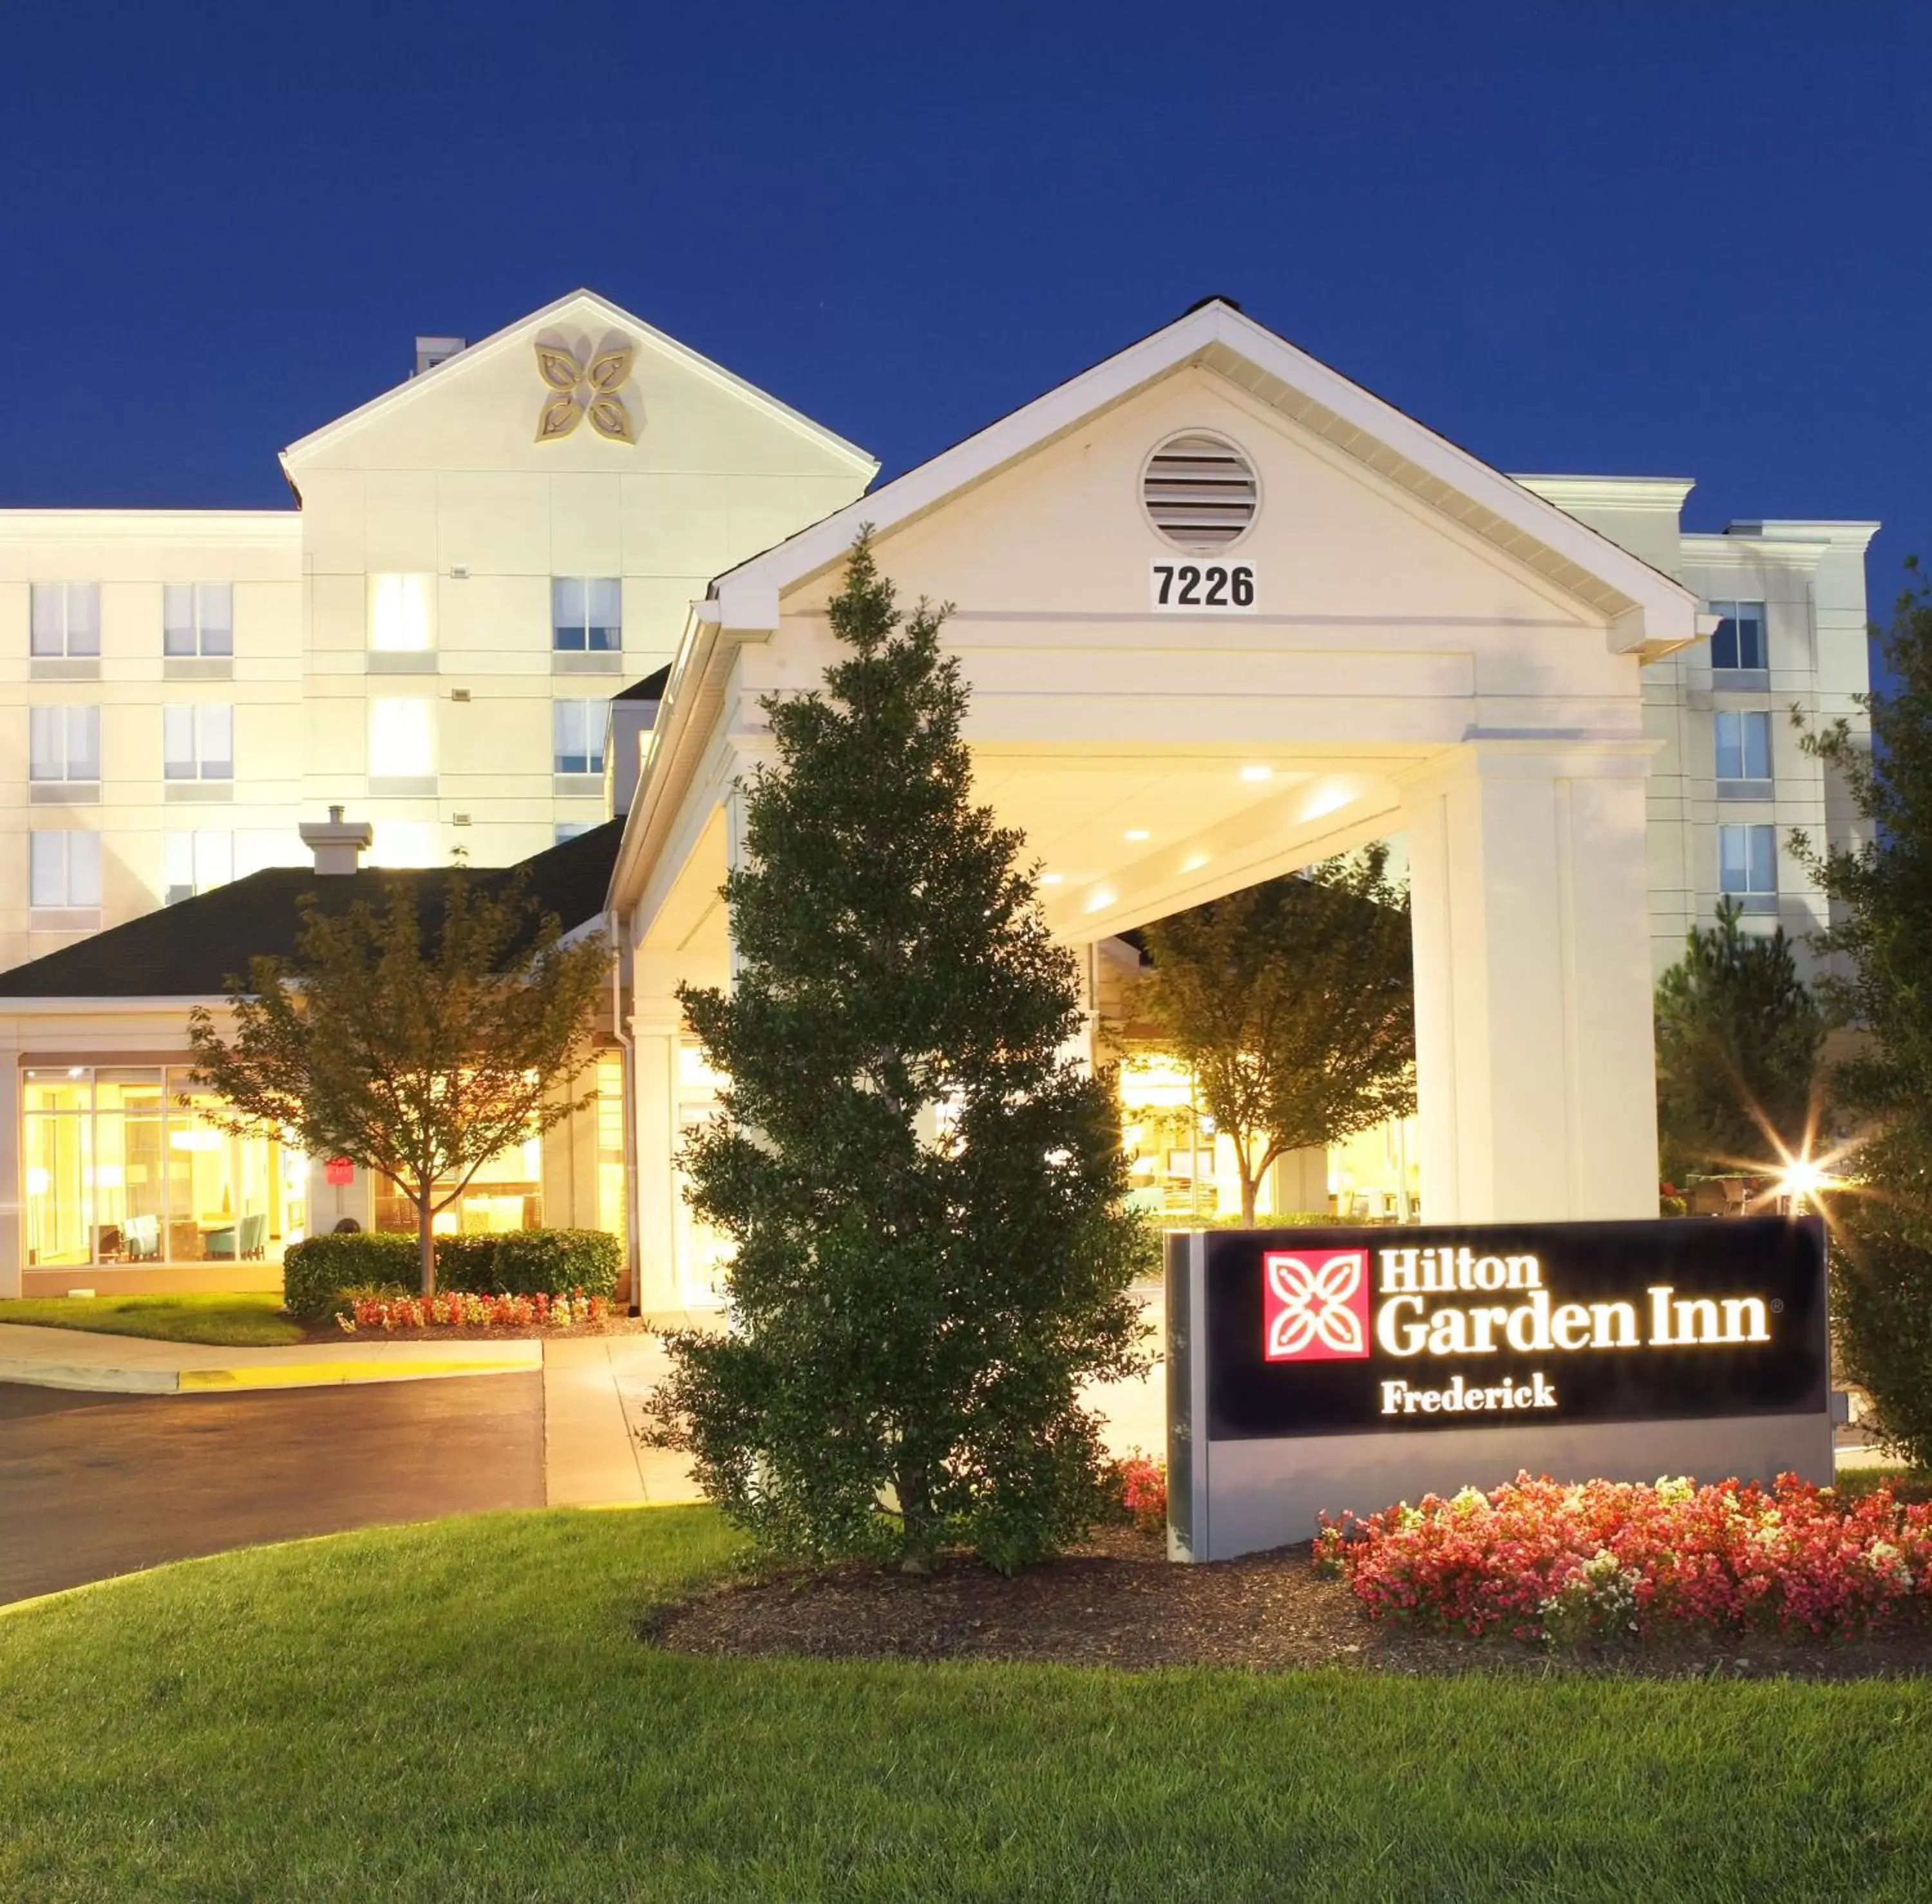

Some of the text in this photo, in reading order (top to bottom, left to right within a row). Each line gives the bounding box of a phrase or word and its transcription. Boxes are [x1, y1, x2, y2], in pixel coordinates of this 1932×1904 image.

[1153, 566, 1254, 606] 7226
[1379, 1247, 1542, 1293] Hilton
[1377, 1286, 1770, 1357] Garden Inn
[1380, 1372, 1557, 1414] Frederick
